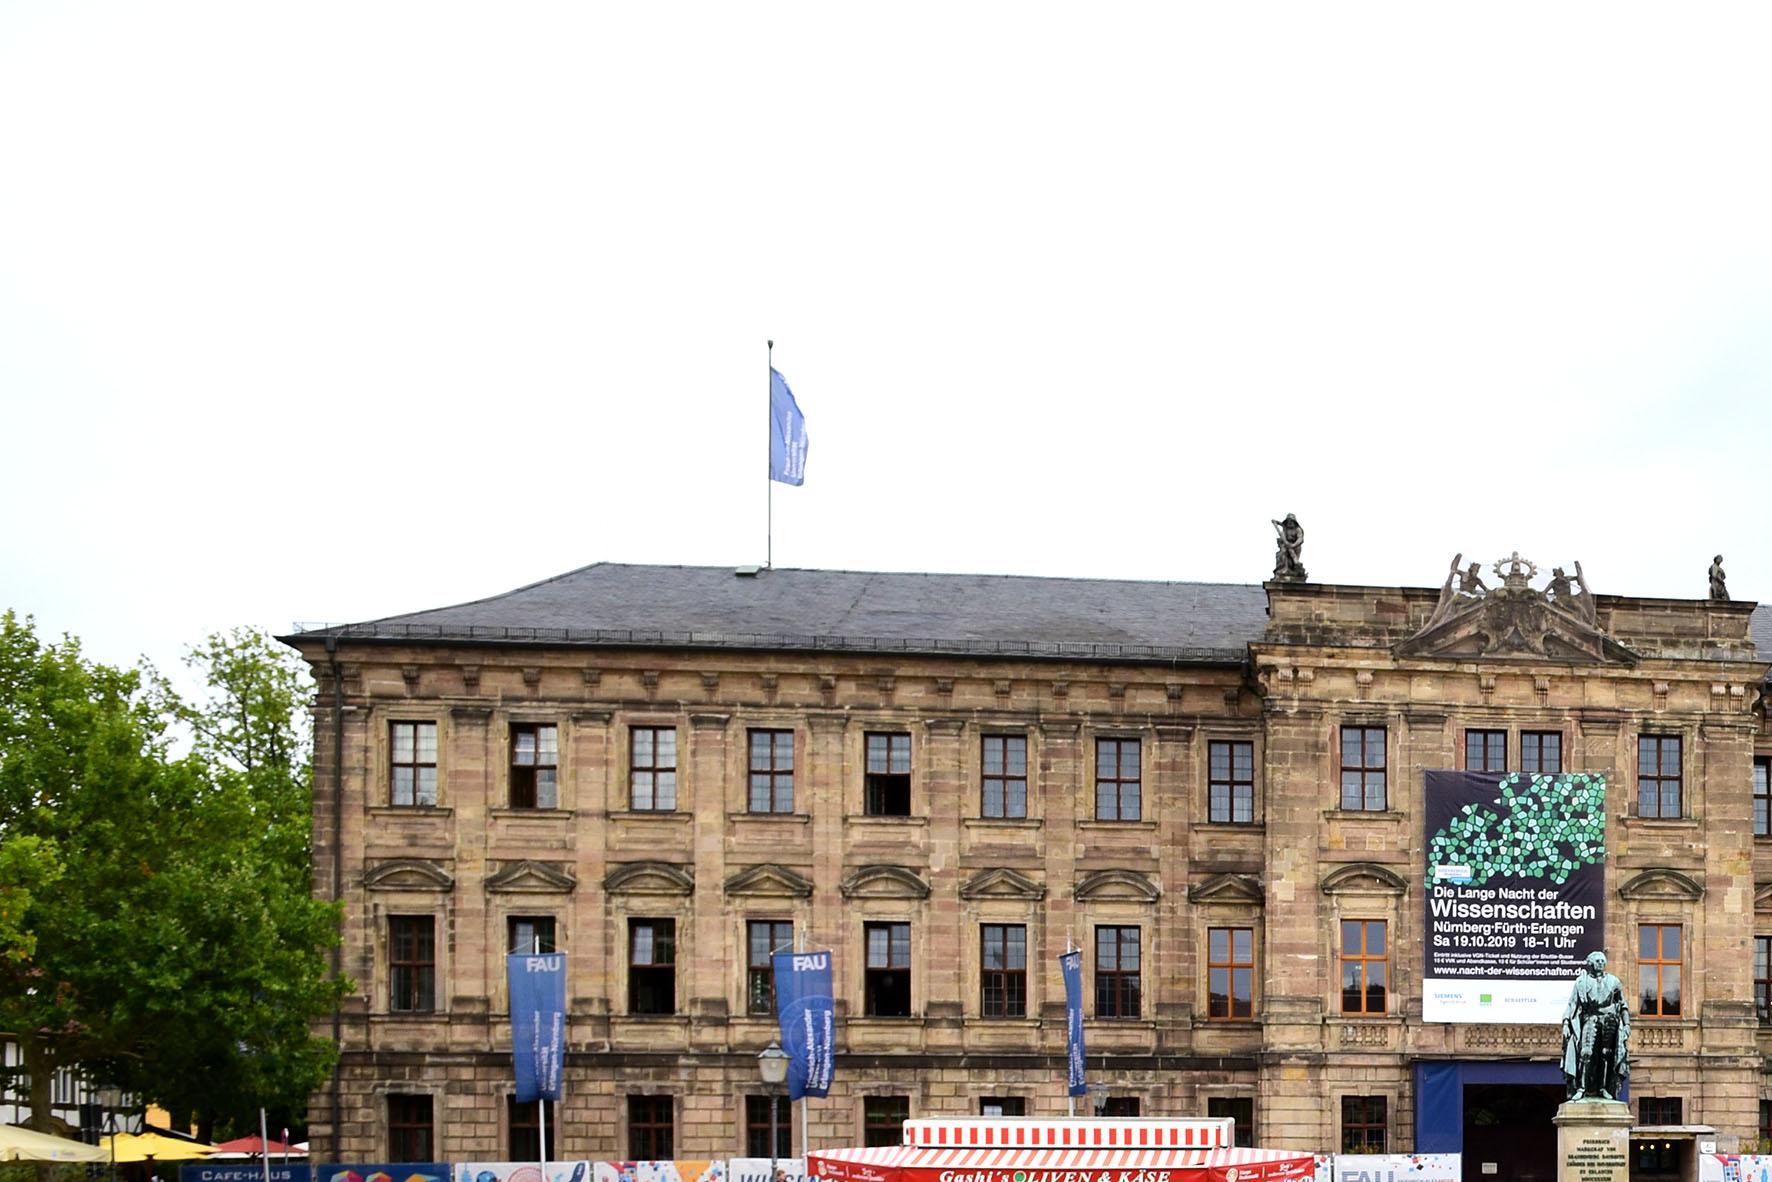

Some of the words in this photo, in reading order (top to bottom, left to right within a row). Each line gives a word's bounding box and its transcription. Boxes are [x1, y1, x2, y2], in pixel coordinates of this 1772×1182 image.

[1434, 886, 1454, 898] Die
[1457, 887, 1496, 901] Lange
[1499, 888, 1535, 899] Nacht
[1538, 888, 1559, 900] der
[1430, 899, 1596, 919] Wissenschaften
[1433, 935, 1450, 947] Sa
[1453, 936, 1516, 947] 19.10.2019
[1554, 937, 1577, 948] Uhr
[526, 957, 560, 972] FAU
[793, 955, 827, 972] FAU
